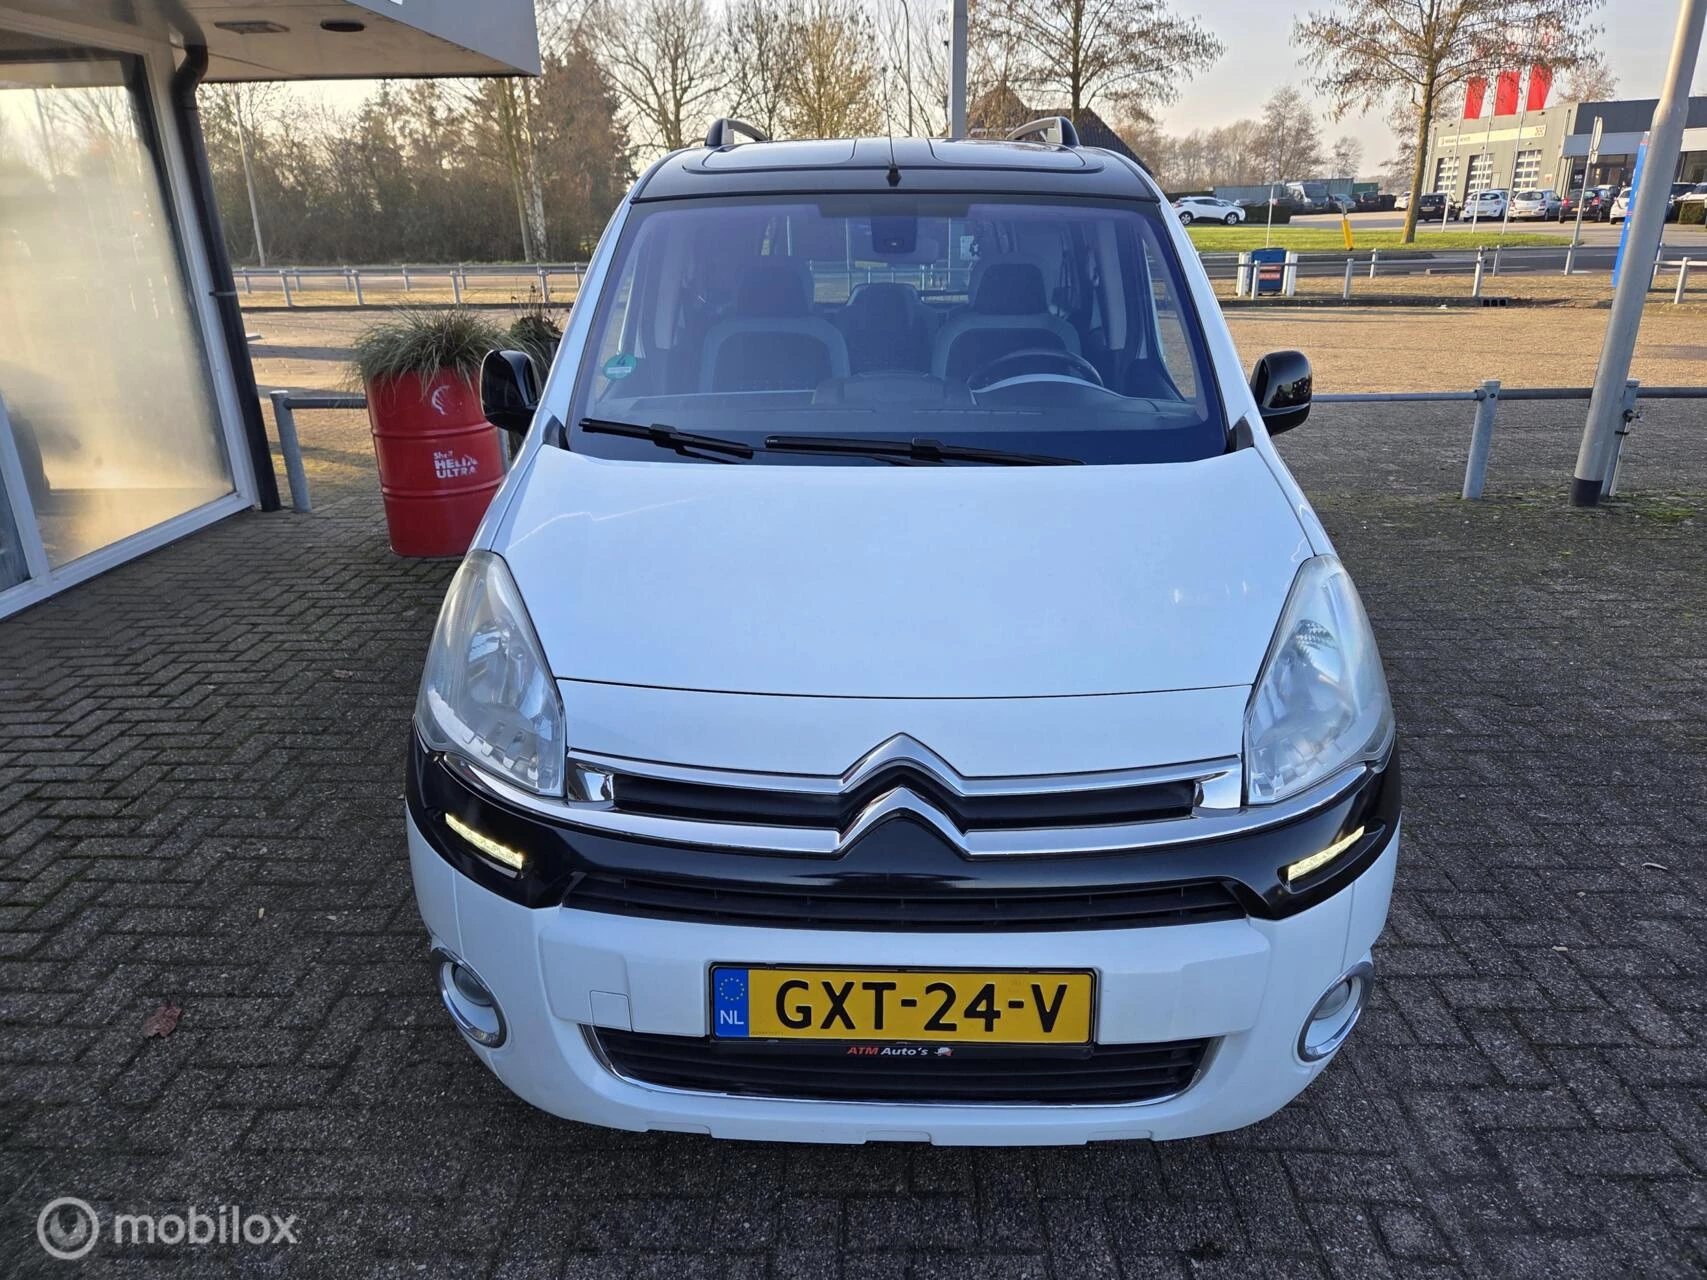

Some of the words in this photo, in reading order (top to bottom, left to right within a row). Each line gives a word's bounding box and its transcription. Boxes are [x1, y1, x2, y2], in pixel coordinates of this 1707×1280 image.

[775, 979, 1068, 1033] GXT-24-V
[720, 1009, 744, 1026] NL
[847, 1046, 879, 1056] ATM
[880, 1047, 929, 1056] Auto's
